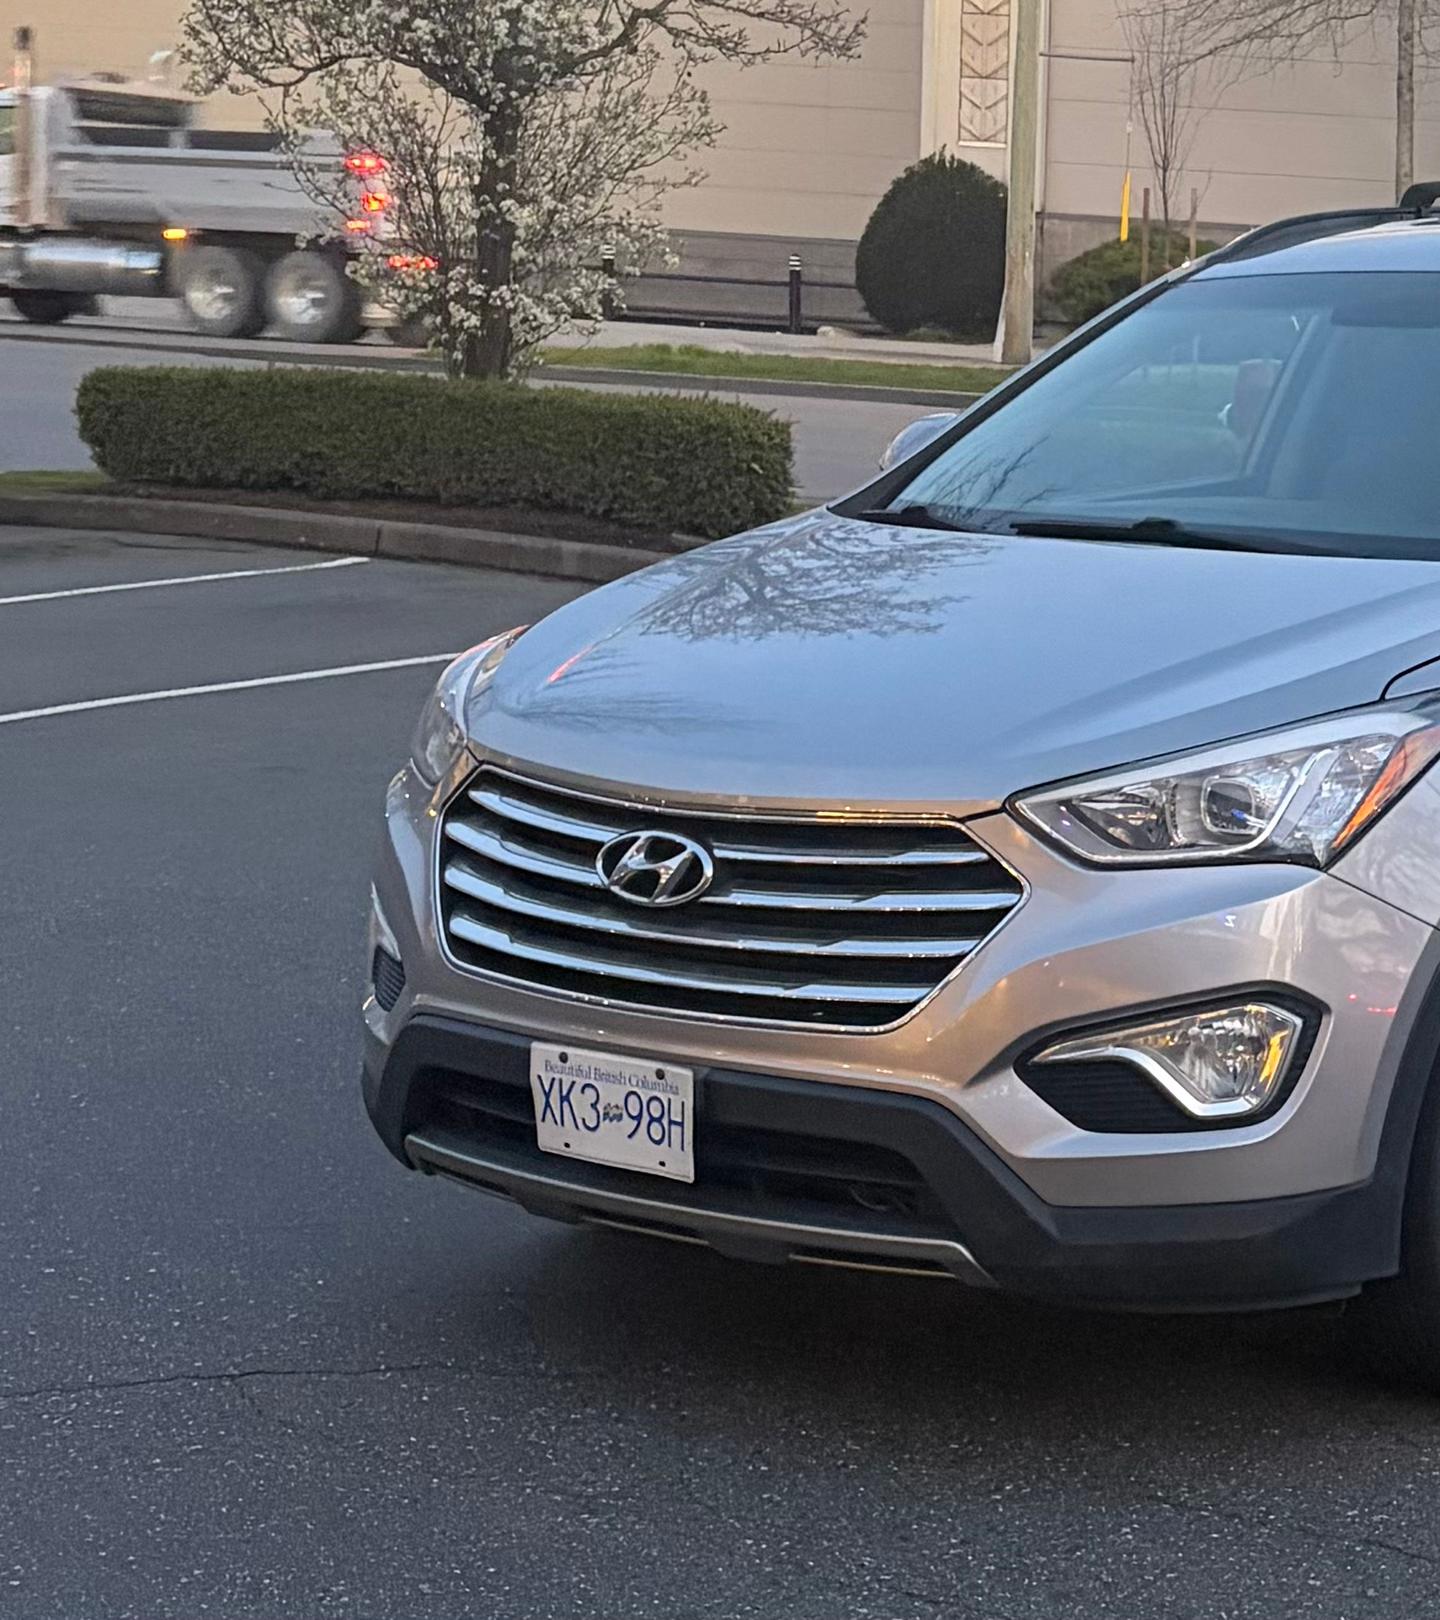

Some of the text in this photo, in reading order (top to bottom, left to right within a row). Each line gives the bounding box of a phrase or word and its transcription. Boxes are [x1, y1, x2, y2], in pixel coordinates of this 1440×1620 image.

[544, 1060, 680, 1096] Beautiful British Columbia
[537, 1074, 685, 1152] XK3 98H
